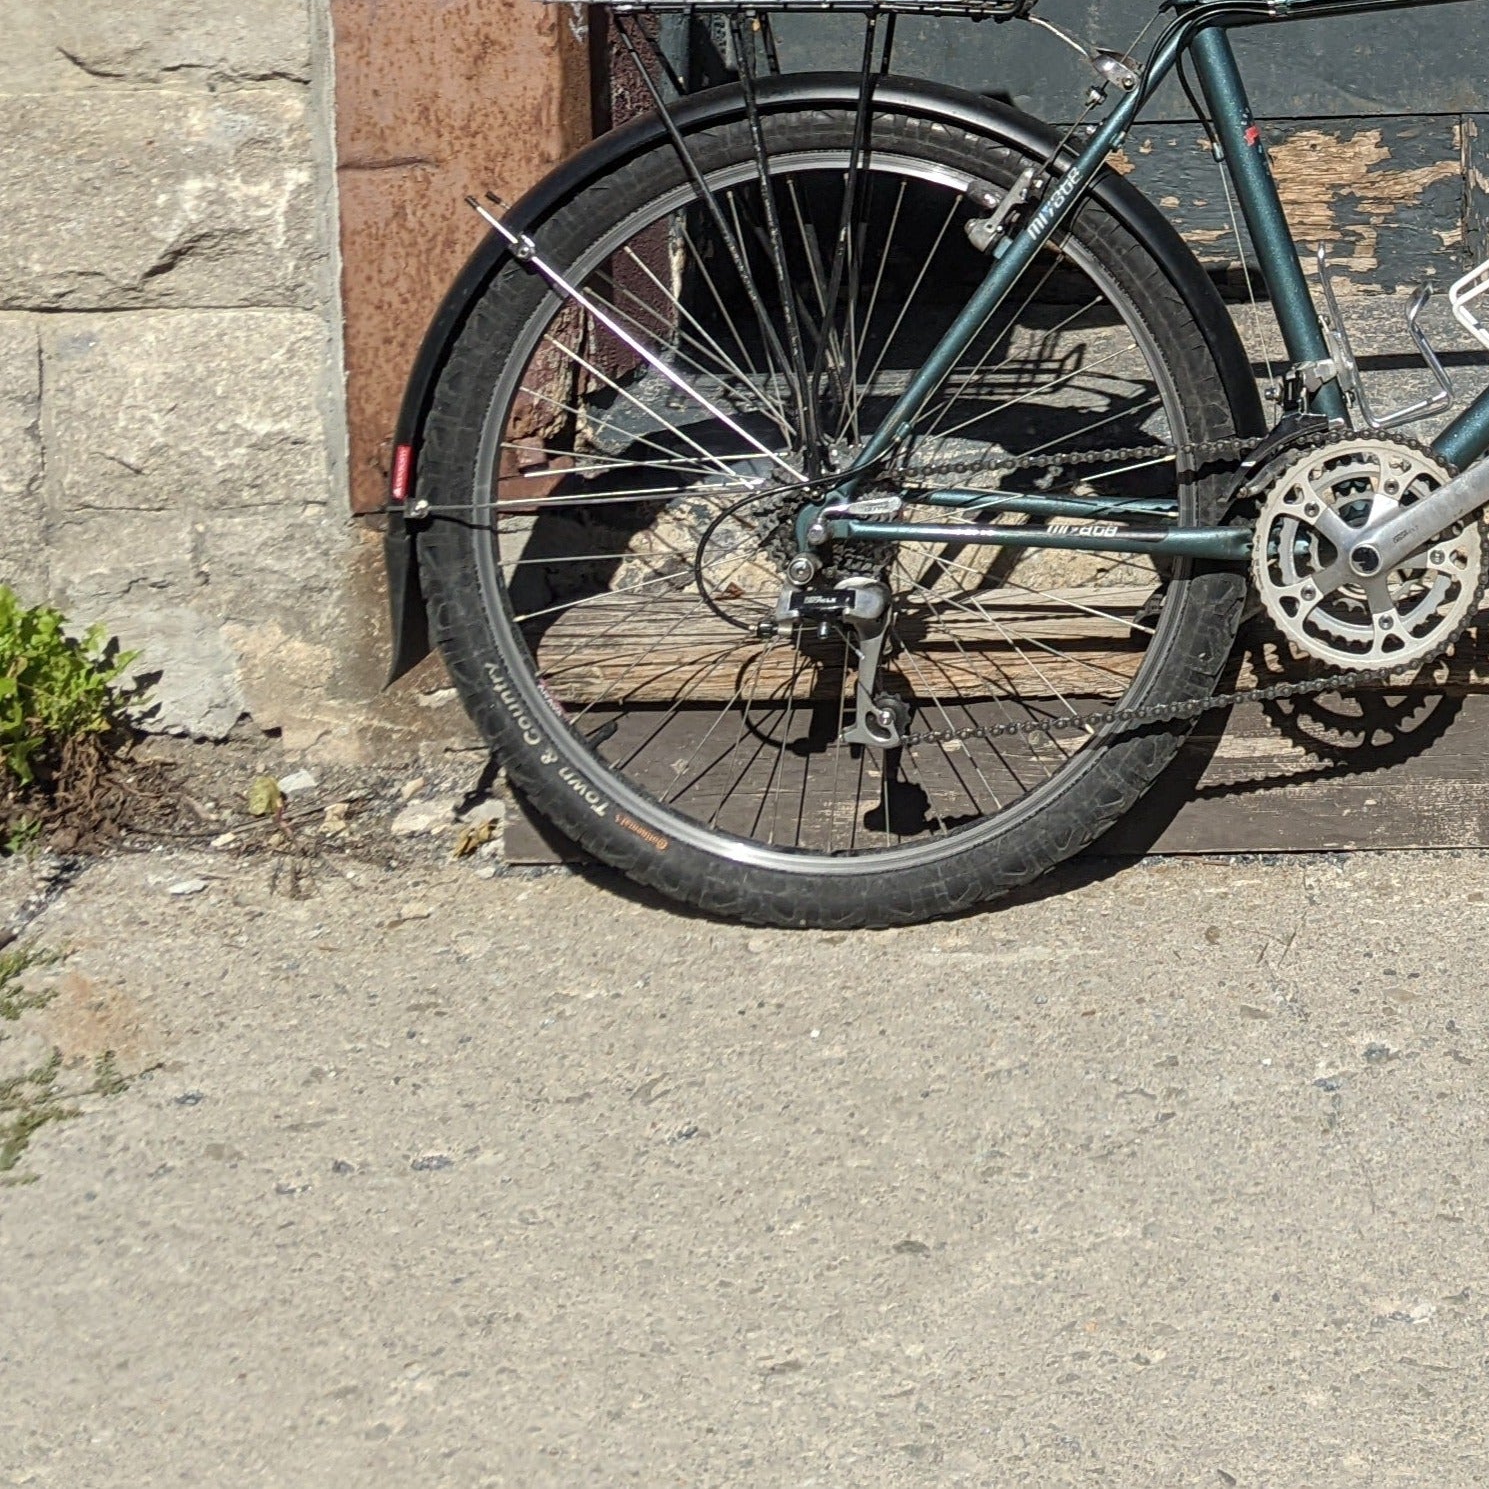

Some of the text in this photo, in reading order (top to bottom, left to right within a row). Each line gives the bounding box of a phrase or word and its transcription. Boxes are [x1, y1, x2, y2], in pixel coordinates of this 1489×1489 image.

[484, 662, 541, 746] Country
[540, 746, 559, 765] &
[558, 768, 608, 818] Town
